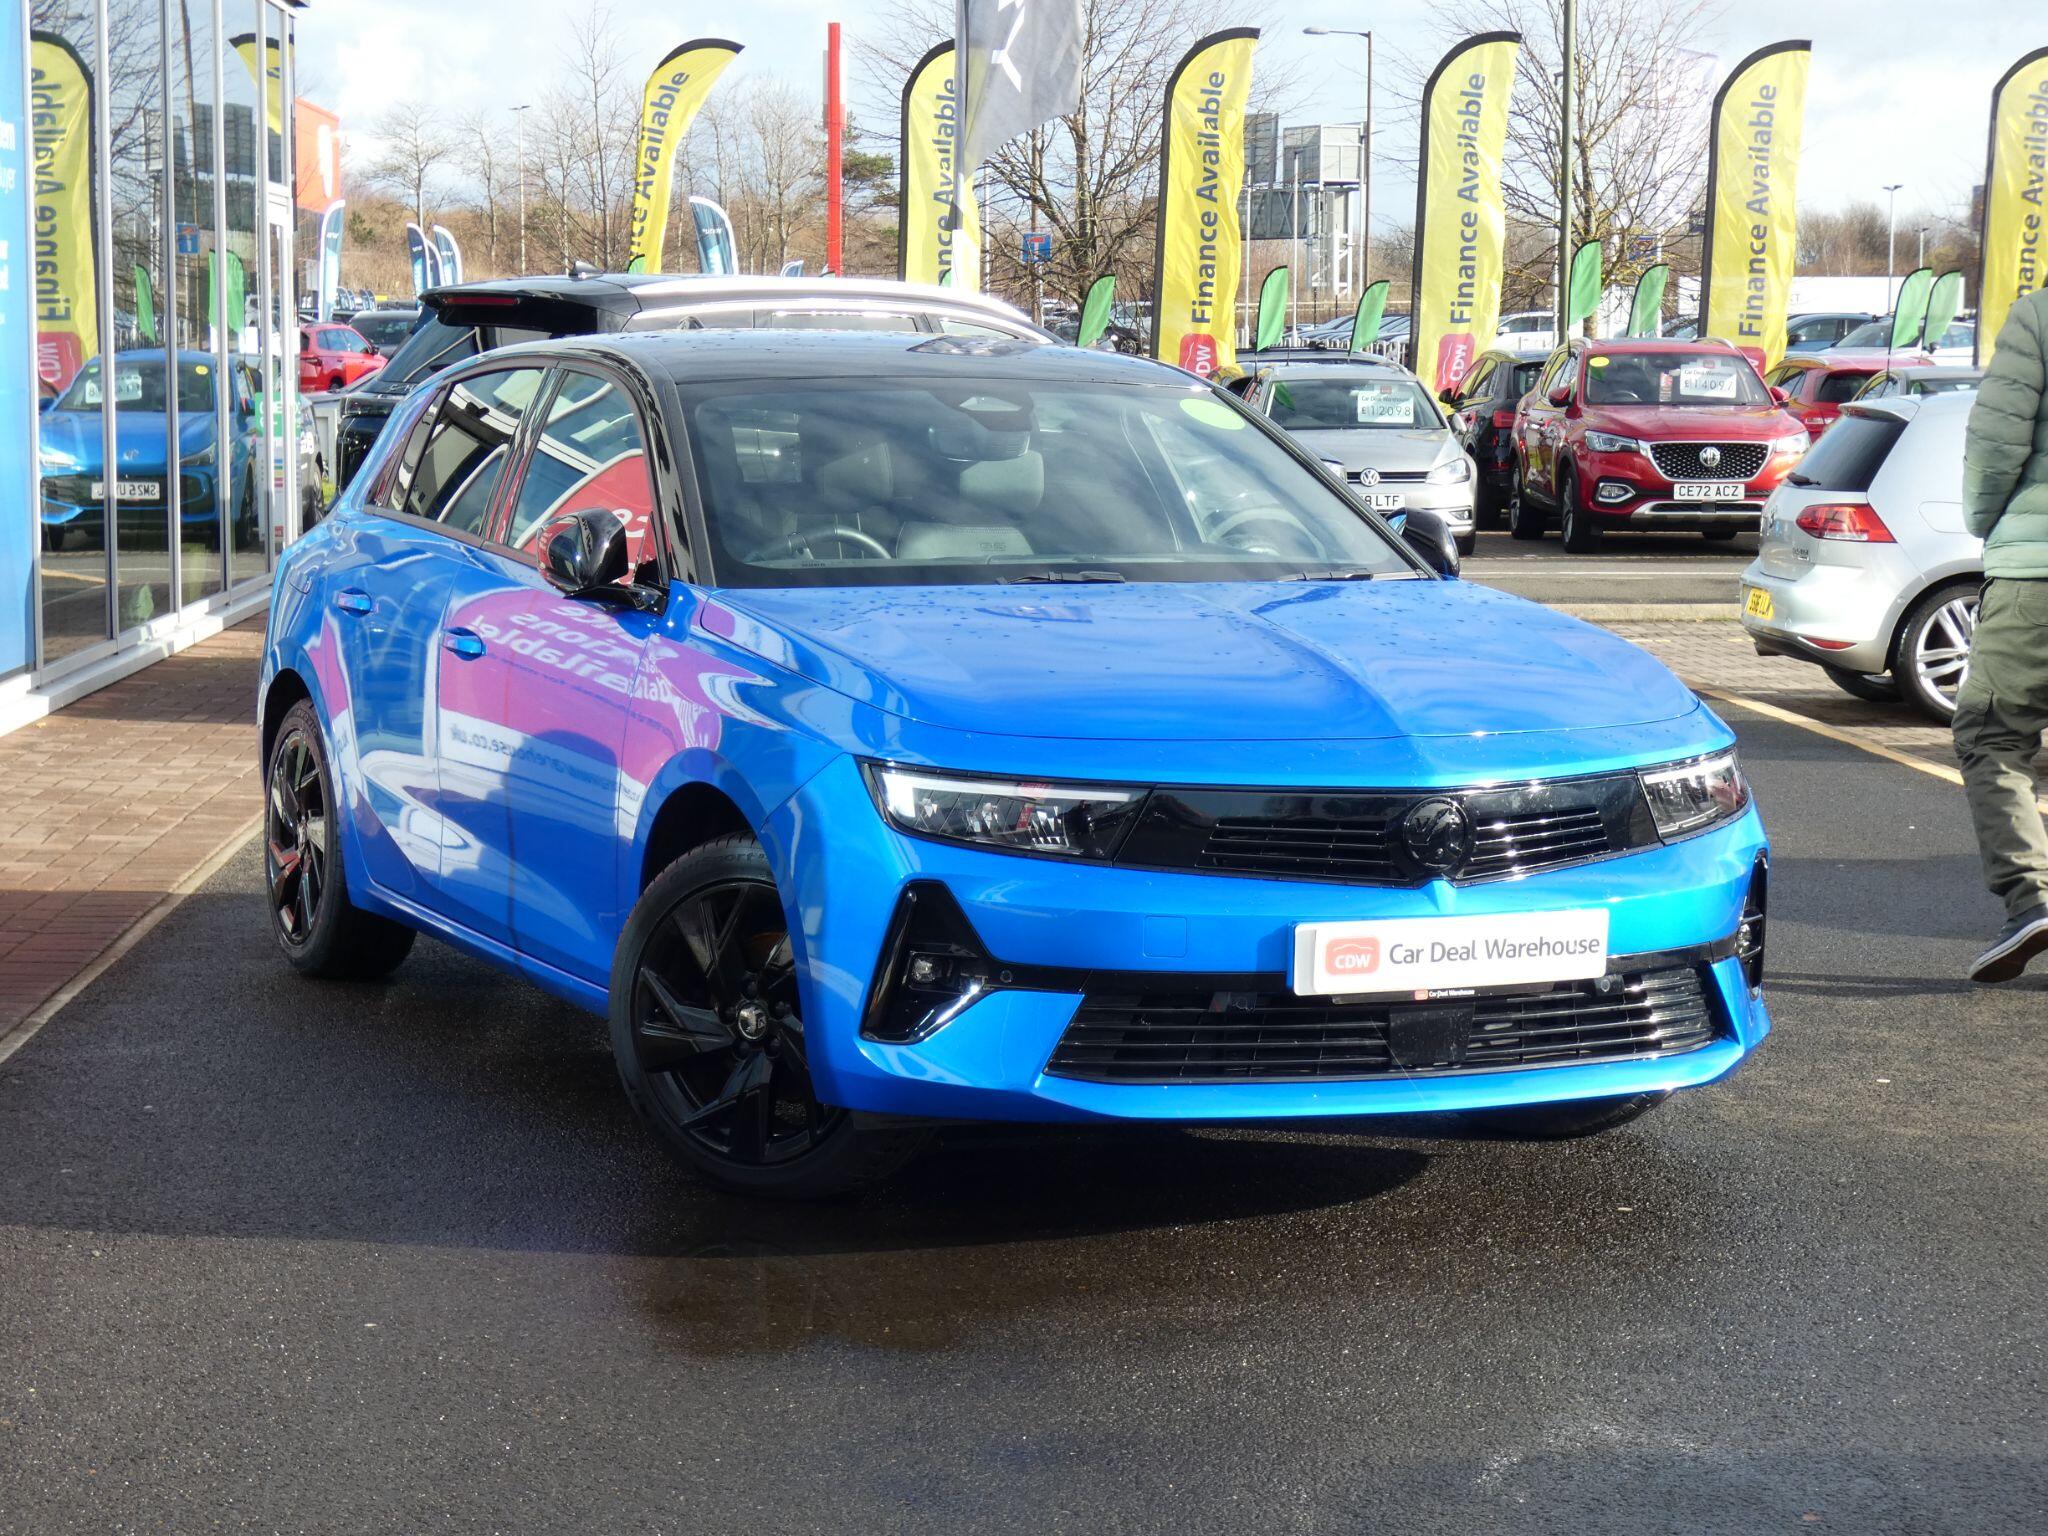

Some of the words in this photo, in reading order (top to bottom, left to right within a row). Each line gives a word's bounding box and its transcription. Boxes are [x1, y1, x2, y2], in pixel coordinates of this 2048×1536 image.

[635, 72, 690, 200] Available
[1196, 71, 1226, 204] Available
[1456, 72, 1486, 204] Available
[1745, 84, 1777, 216] Available
[2021, 79, 2048, 206] Available
[1191, 210, 1218, 324] Finance
[1450, 210, 1479, 324] Finance
[1738, 223, 1768, 337] Finance
[2015, 213, 2041, 300] nance
[1450, 344, 1468, 381] CDW
[1375, 495, 1399, 507] LTF
[1679, 485, 1711, 497] CE72
[1715, 485, 1739, 497] ACZ
[1334, 953, 1371, 970] CDW
[1389, 943, 1424, 965] Car
[1430, 939, 1477, 963] Deal
[1485, 935, 1600, 959] Warehouse
